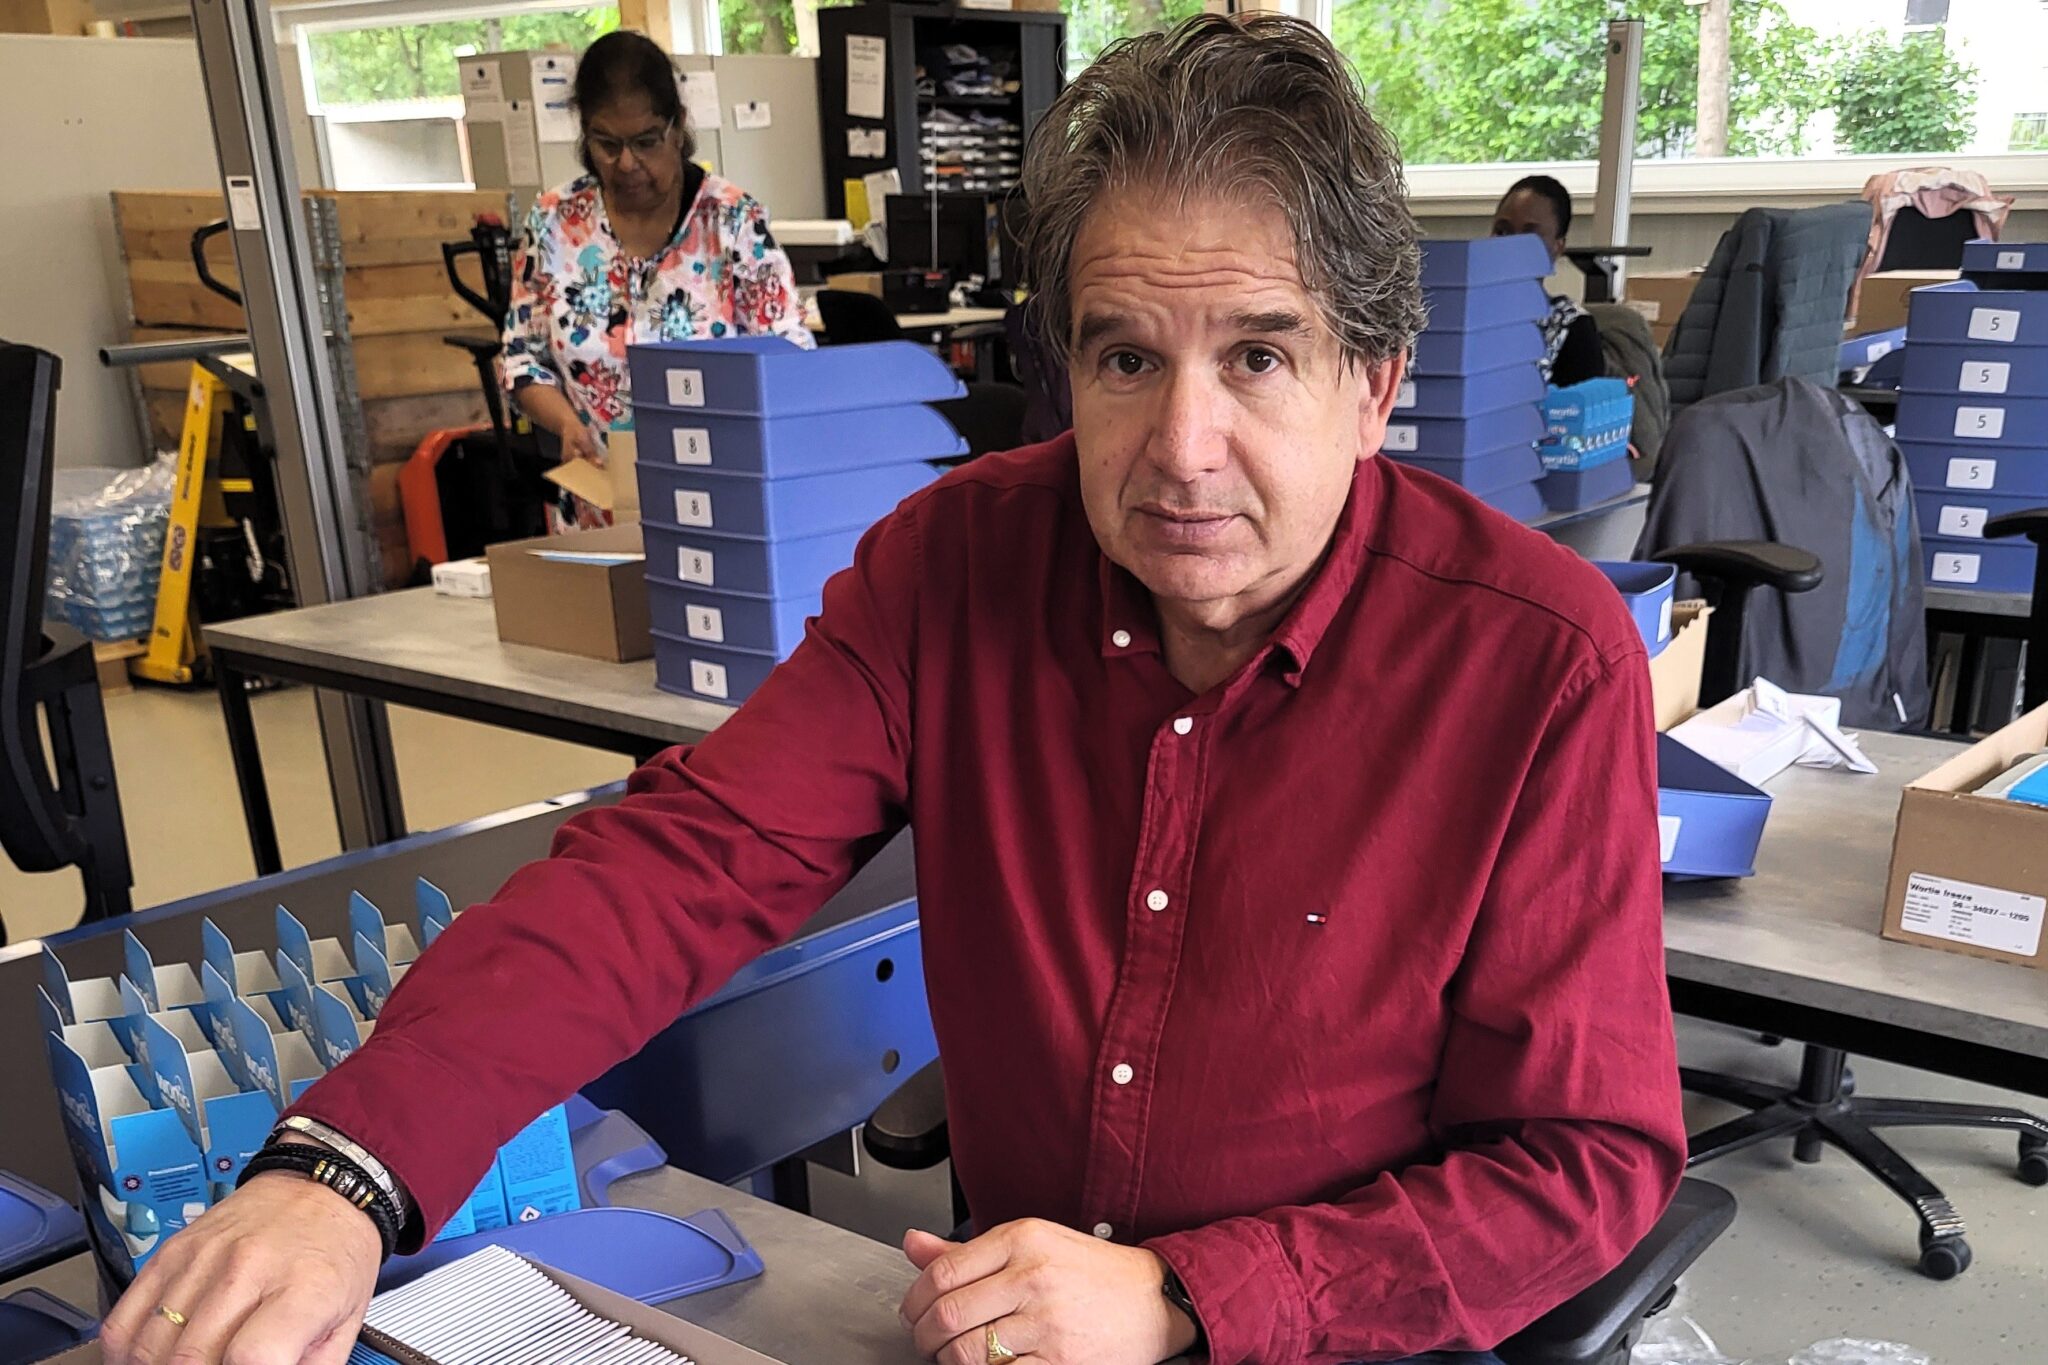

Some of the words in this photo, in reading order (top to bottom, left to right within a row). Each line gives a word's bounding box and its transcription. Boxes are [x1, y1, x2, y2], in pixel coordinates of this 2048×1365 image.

[1990, 316, 2000, 331] 5
[1980, 368, 1990, 383] 5
[1976, 414, 1987, 430] 5
[1969, 465, 1979, 480] 5
[1959, 513, 1969, 528] 5
[1952, 559, 1962, 574] 5
